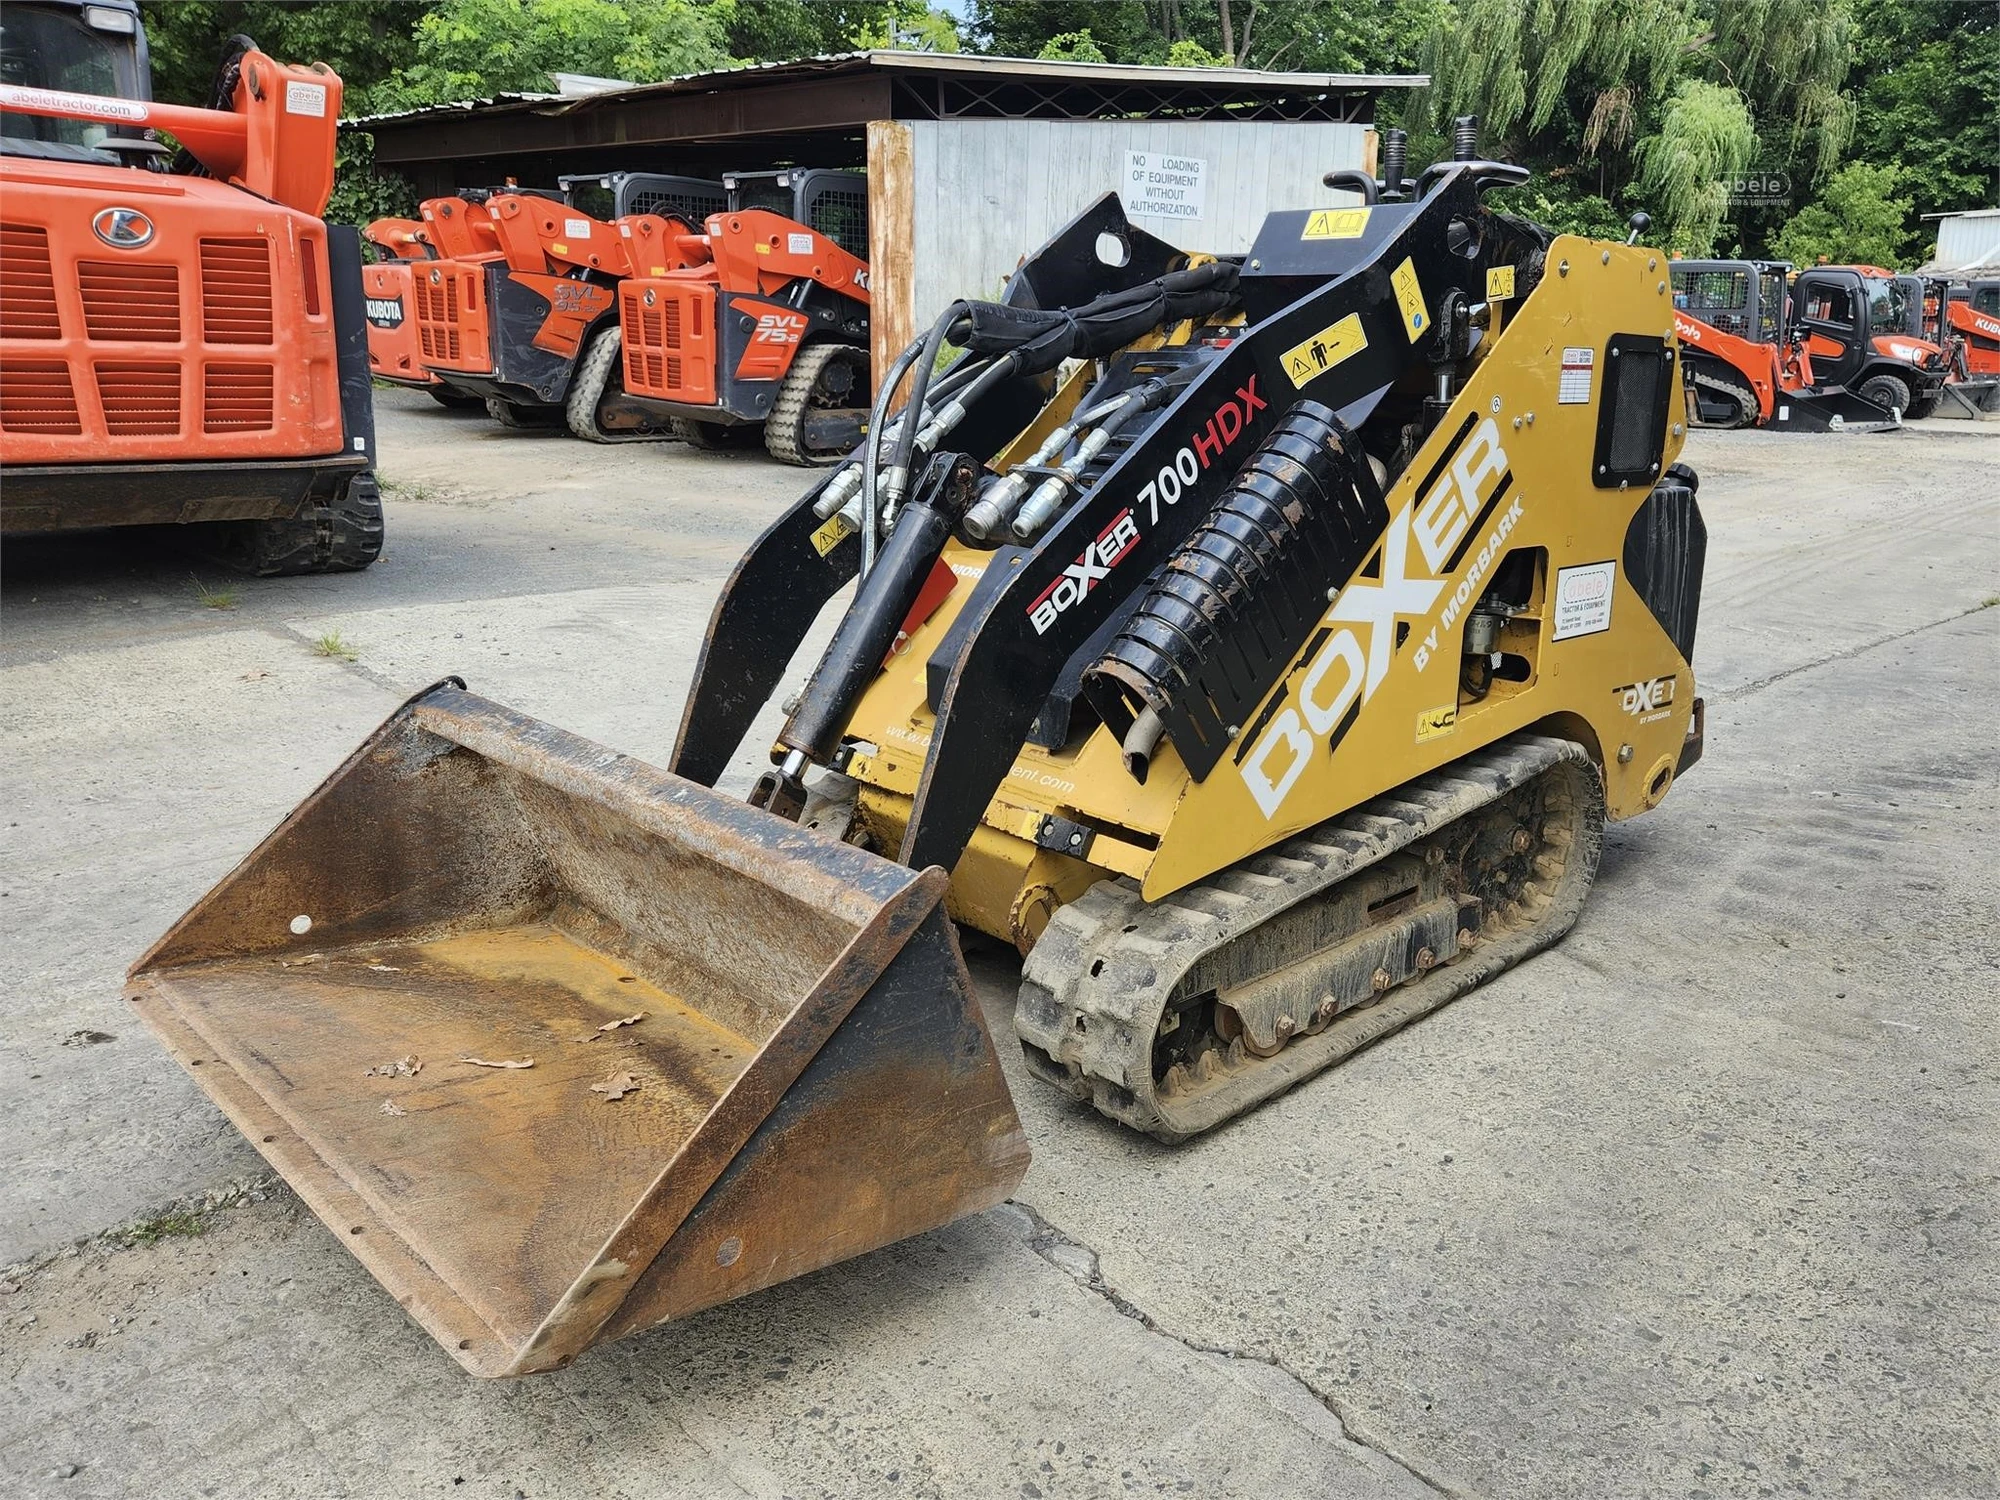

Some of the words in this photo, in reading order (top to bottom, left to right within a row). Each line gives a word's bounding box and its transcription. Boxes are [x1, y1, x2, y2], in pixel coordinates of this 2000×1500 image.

[11, 92, 131, 116] abeletractor.com
[1132, 154, 1146, 167] NO
[1162, 158, 1200, 173] LOADING
[1132, 169, 1145, 181] OF
[1148, 171, 1198, 187] EQUIPMENT
[1145, 186, 1185, 200] WITHOUT
[1129, 199, 1198, 216] AUTHORIZATION
[554, 283, 603, 301] SVL
[365, 299, 403, 320] KUBOTA
[758, 314, 804, 328] SVL
[756, 328, 799, 343] 75-2
[1028, 515, 1139, 636] BOXER
[1412, 626, 1439, 673] BY
[1440, 494, 1525, 634] MORBARK
[1240, 416, 1509, 821] BOXER
